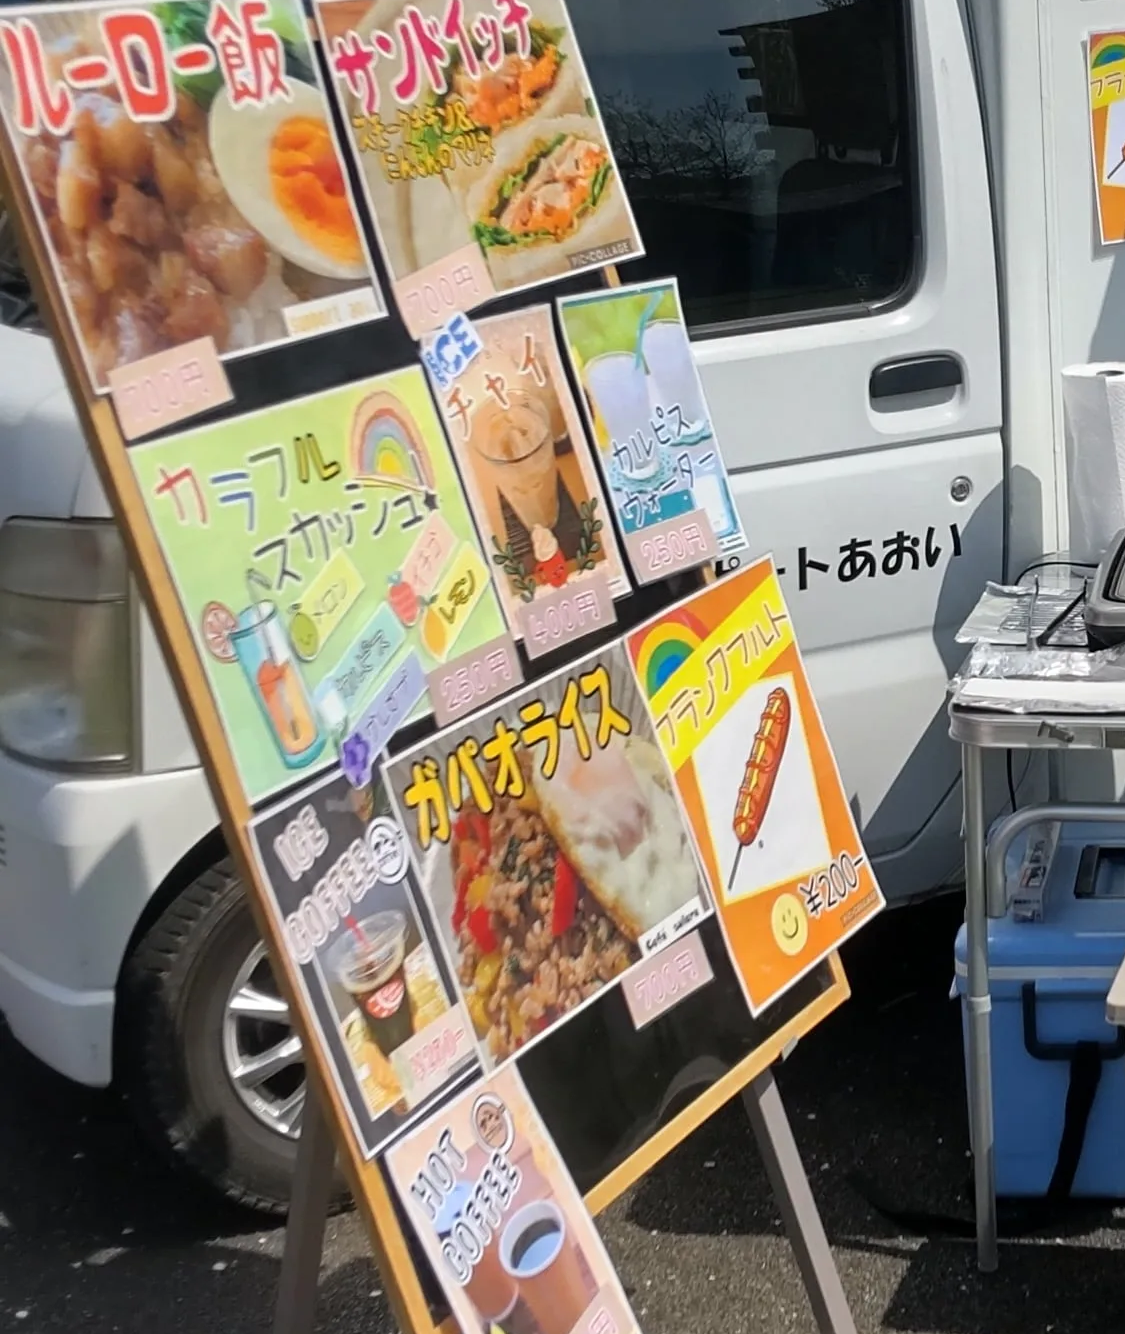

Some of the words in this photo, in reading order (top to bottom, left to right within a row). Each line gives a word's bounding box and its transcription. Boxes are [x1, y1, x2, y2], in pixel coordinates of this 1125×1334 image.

[405, 265, 480, 322] 700円
[448, 333, 546, 440] チャイ
[612, 405, 691, 473] カルピス
[155, 433, 342, 531] カラフル
[623, 452, 715, 527] ウォーター
[253, 481, 424, 591] スカッシュ
[641, 523, 708, 571] 250円
[528, 589, 600, 645] 400円
[441, 649, 512, 711] 250円
[655, 603, 790, 745] フランクフルト
[404, 664, 632, 851] ガパオライス
[273, 805, 328, 881] ICE
[285, 838, 382, 965] COFFEE
[635, 948, 698, 1011] 700円
[410, 1127, 466, 1221] HOT
[441, 1148, 522, 1286] COFFEE
